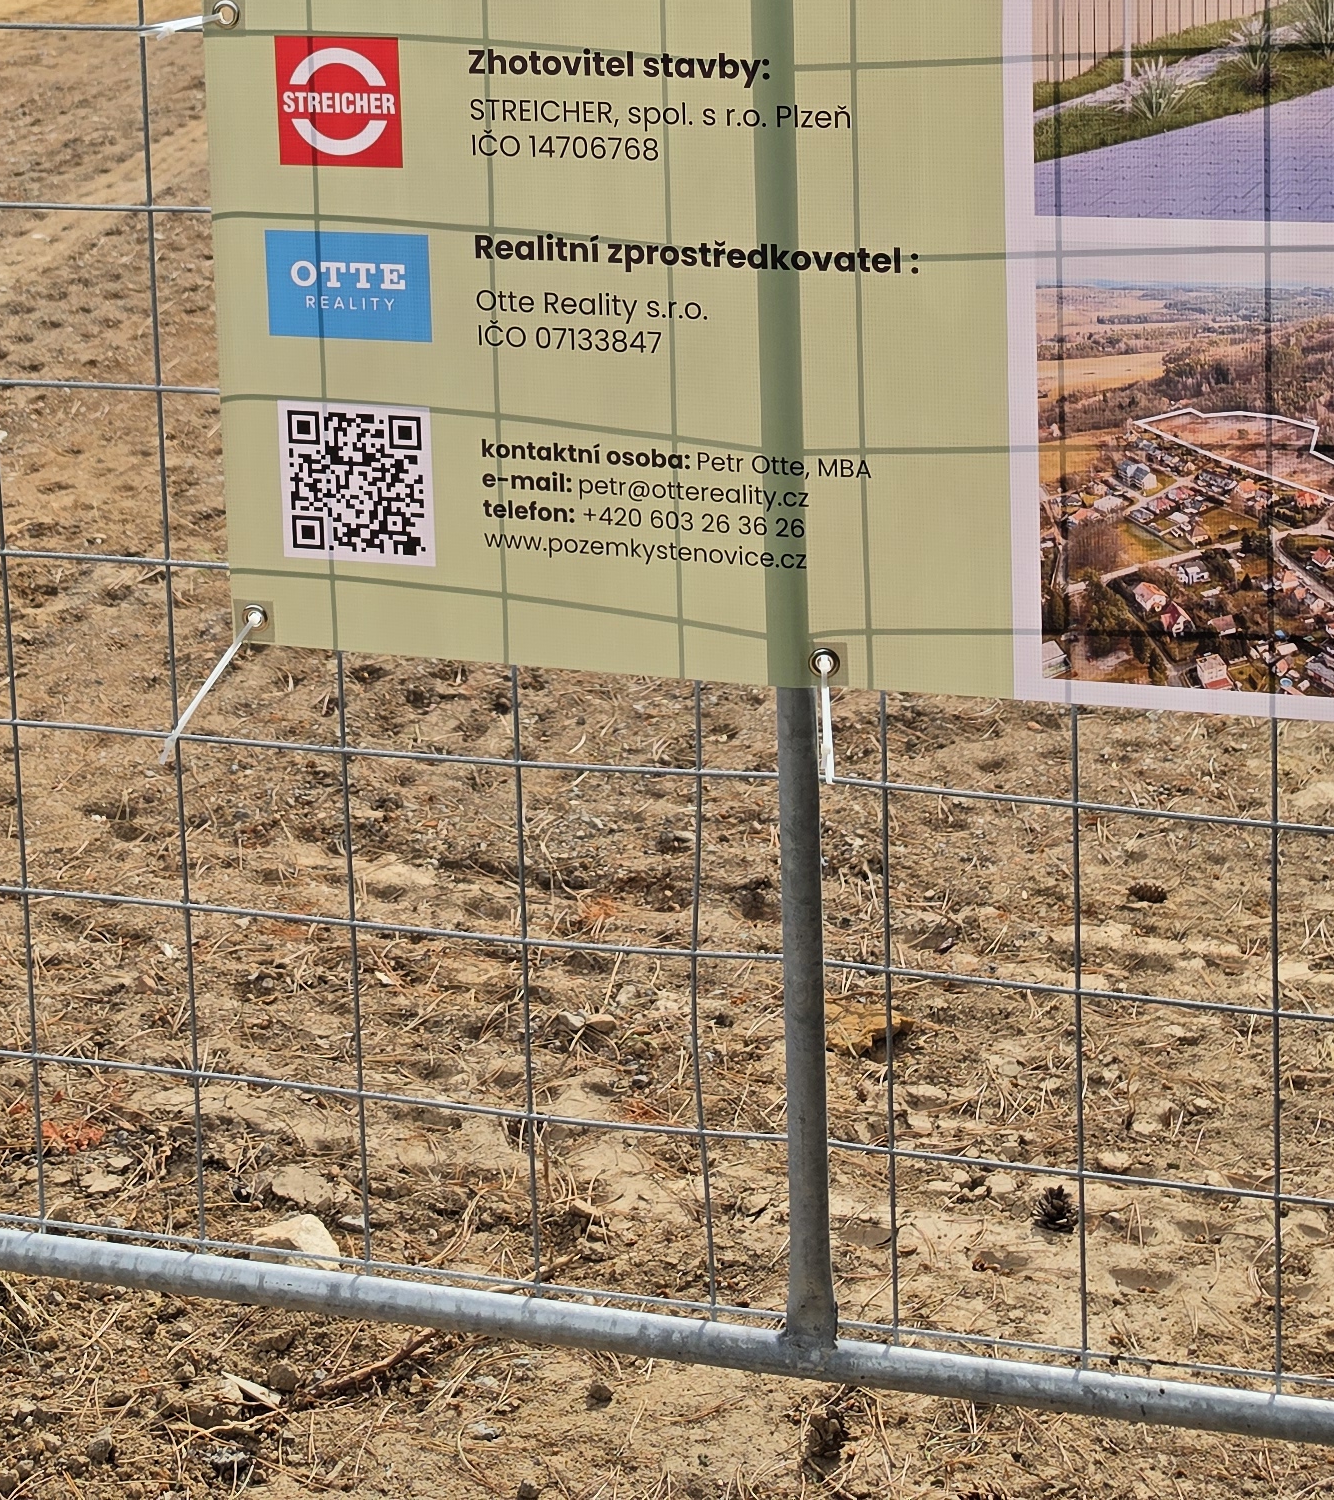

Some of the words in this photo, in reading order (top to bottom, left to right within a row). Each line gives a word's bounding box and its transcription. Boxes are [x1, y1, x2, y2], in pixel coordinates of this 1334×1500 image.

[468, 47, 634, 77] Zhotovitel
[642, 52, 771, 89] stavby:
[282, 91, 396, 115] STREICHER
[470, 98, 619, 128] STREICHER,
[628, 101, 693, 133] spol.
[702, 107, 716, 126] s
[726, 108, 767, 128] r.o.
[776, 104, 851, 129] Plzeň
[471, 129, 521, 157] IČO
[528, 134, 659, 162] 14706768
[474, 232, 599, 263] Realitní
[607, 239, 902, 274] zprostředkovatel
[290, 260, 406, 290] OTTE
[305, 295, 395, 311] REALITY
[476, 289, 535, 313] Otte
[544, 291, 638, 325] Reality
[646, 300, 708, 321] s.r.o.
[478, 319, 527, 348] IČO
[535, 326, 662, 354] 07133847
[481, 438, 601, 465] kontaktní
[606, 448, 691, 470] osoba:
[697, 451, 744, 473] Petr
[751, 455, 810, 480] Otte,
[818, 457, 872, 479] MBA
[482, 471, 573, 493] e-mail:
[578, 477, 810, 509] petr@ottereality.cz
[482, 499, 575, 524] telefon:
[583, 506, 642, 528] +420
[650, 509, 694, 532] 603
[701, 513, 730, 534] 26
[738, 515, 768, 536] 36
[775, 517, 805, 539] 26
[483, 532, 808, 570] www.pozemkystenovice.cz
